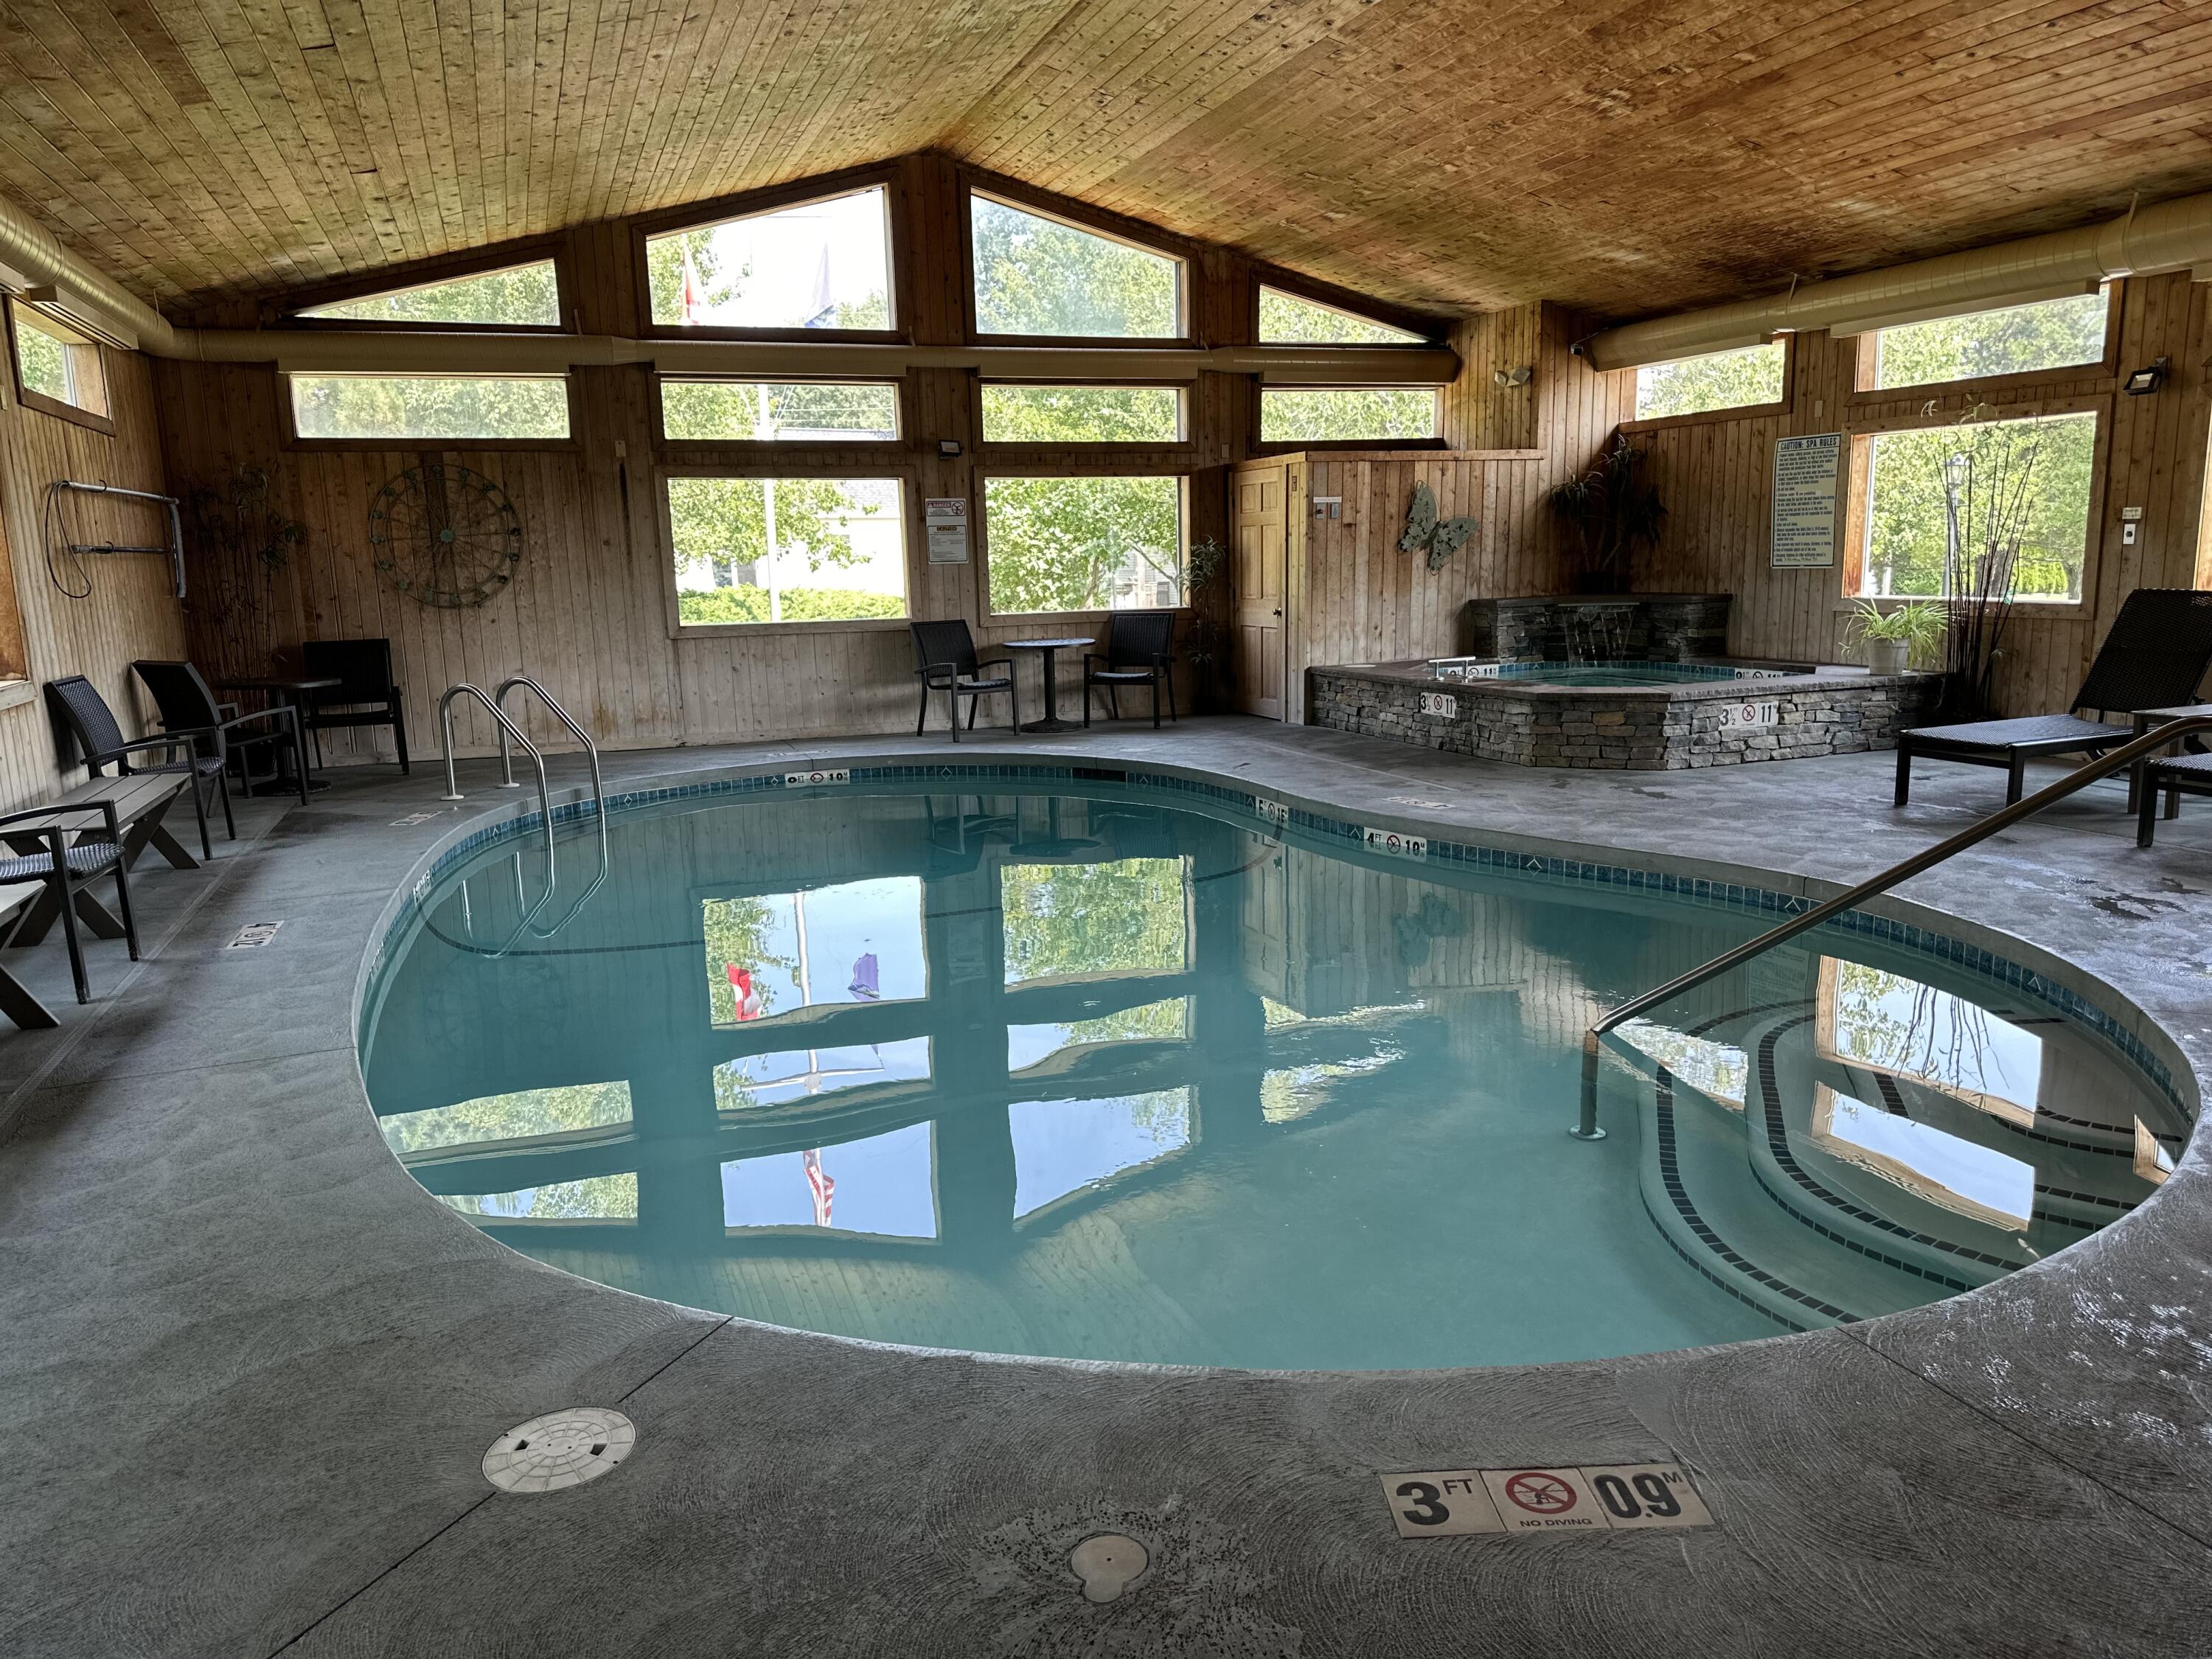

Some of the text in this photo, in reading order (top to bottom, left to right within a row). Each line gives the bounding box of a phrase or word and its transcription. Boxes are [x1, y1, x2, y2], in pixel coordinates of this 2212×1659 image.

[1781, 438, 1837, 450] CAUTION: SPA RULES
[1660, 1471, 1683, 1483] M
[1396, 1478, 1472, 1526] 3 FT
[1545, 1518, 1593, 1526] DIVING
